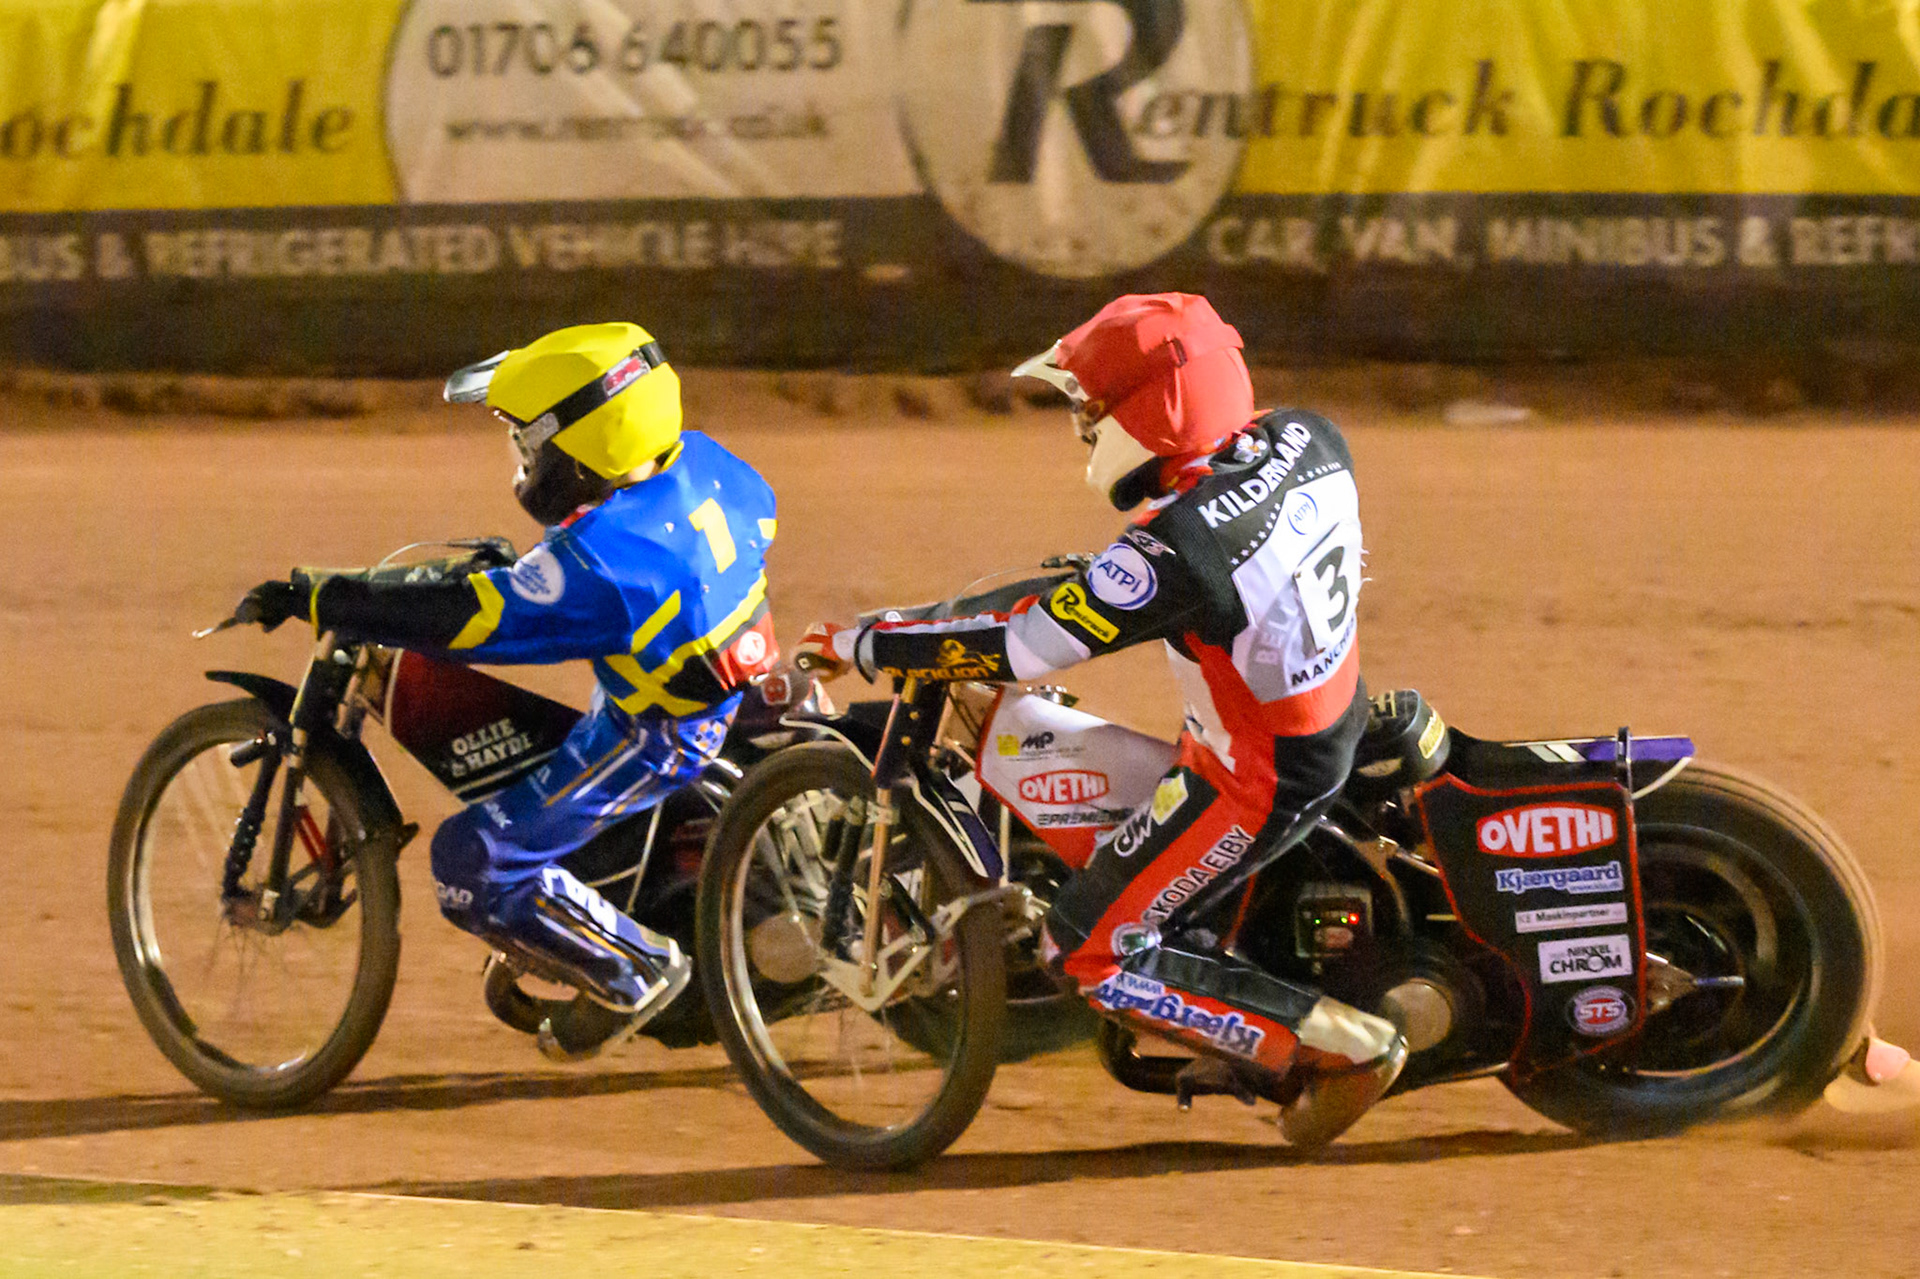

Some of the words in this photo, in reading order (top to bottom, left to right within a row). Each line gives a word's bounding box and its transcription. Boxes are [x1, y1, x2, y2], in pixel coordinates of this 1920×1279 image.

[427, 23, 598, 78] 01706
[618, 16, 842, 76] 640055
[145, 222, 499, 277] REFRIGERATED
[1488, 215, 1726, 267] MINIBUS
[1097, 558, 1143, 594] ATPI
[1313, 545, 1350, 632] 3
[452, 717, 516, 756] OLLIE
[1480, 806, 1614, 854] OVETHI
